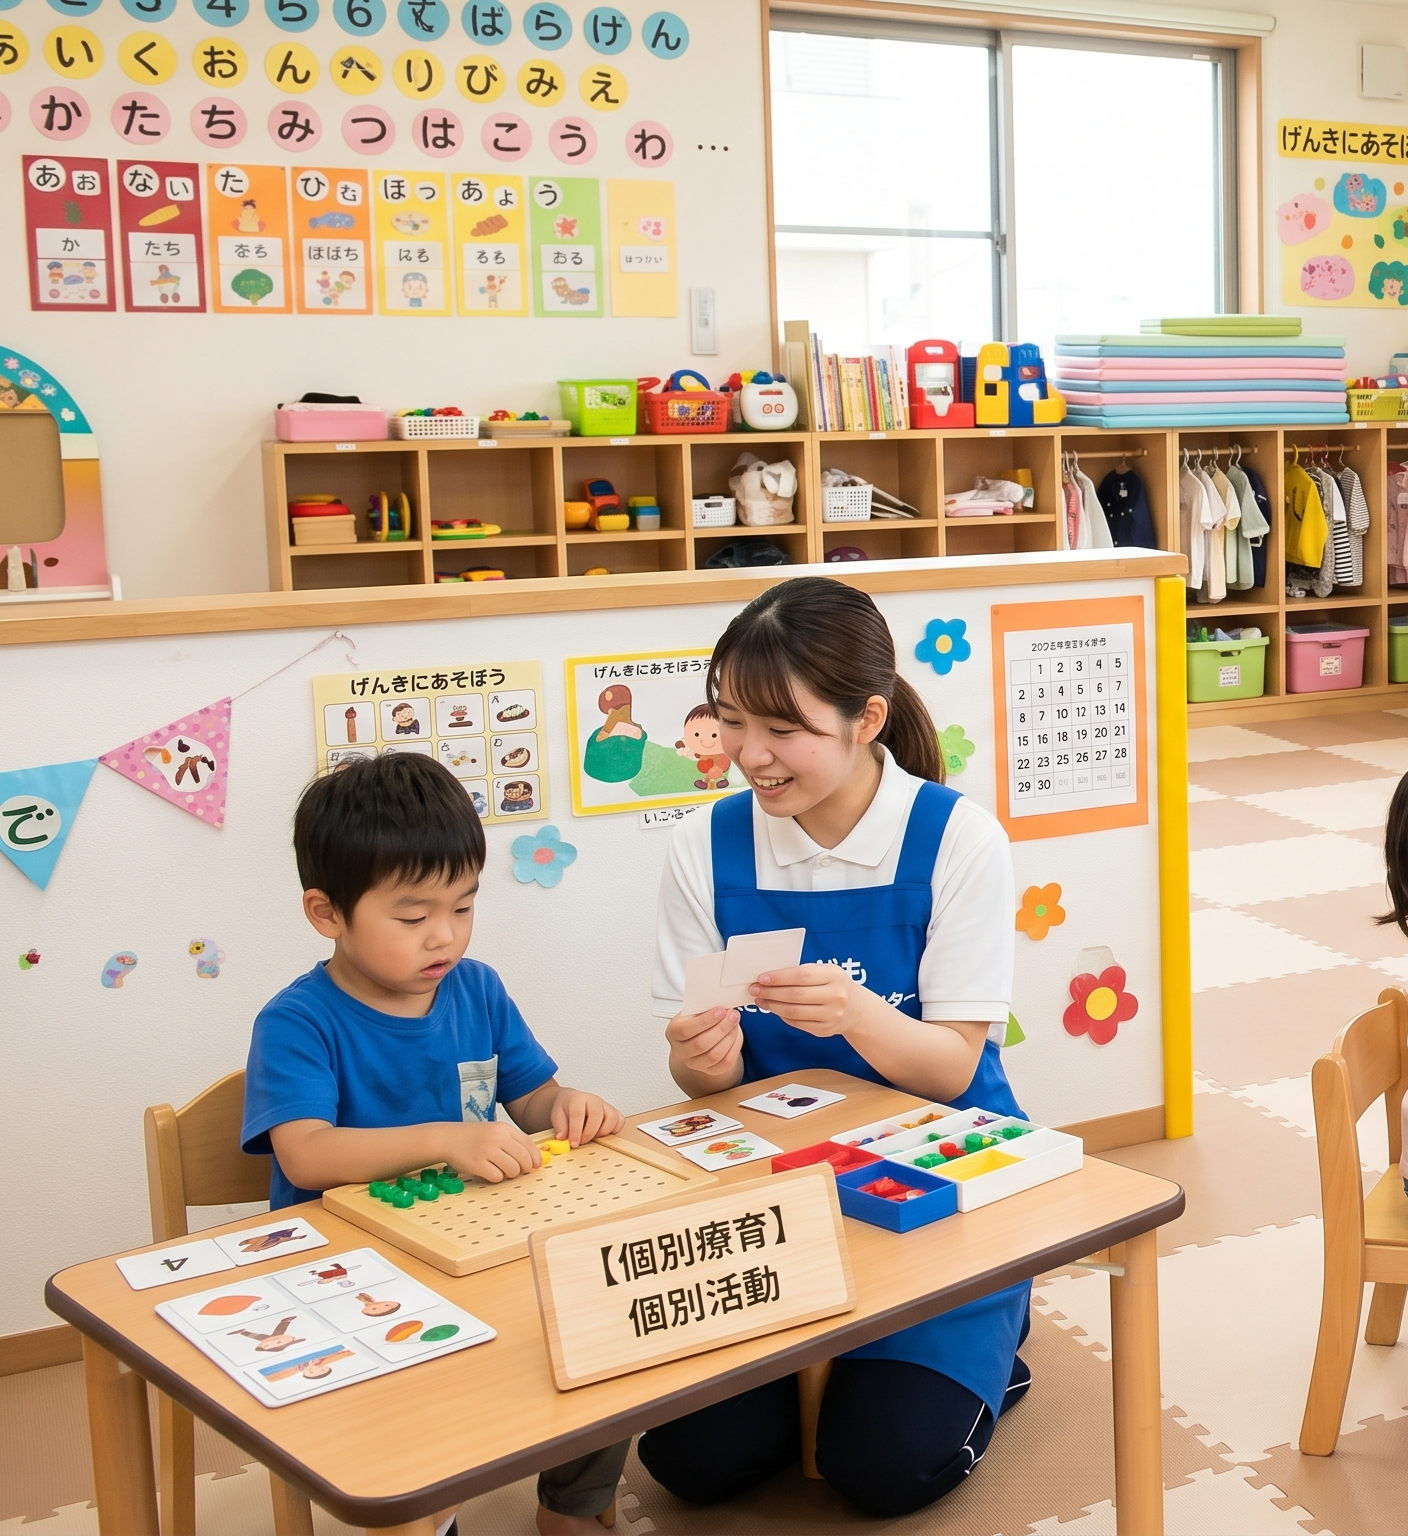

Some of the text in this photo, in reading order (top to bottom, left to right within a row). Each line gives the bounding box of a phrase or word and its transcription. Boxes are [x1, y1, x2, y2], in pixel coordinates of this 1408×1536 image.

[538, 184, 558, 207] う
[61, 237, 80, 252] か
[1038, 657, 1122, 675] 1 2 3 4 5
[1018, 680, 1122, 700] 2 3 4 5 6 7
[1019, 702, 1126, 723] 8 7 10 12 13 14
[1017, 725, 1125, 747] 15 16 18 19 20 21
[1017, 747, 1127, 770] 22 23 25 26 27 28
[1018, 781, 1031, 793] 29
[1037, 779, 1051, 791] 30
[600, 1204, 787, 1288] 【個別療育】
[628, 1264, 781, 1337] 個別活動
